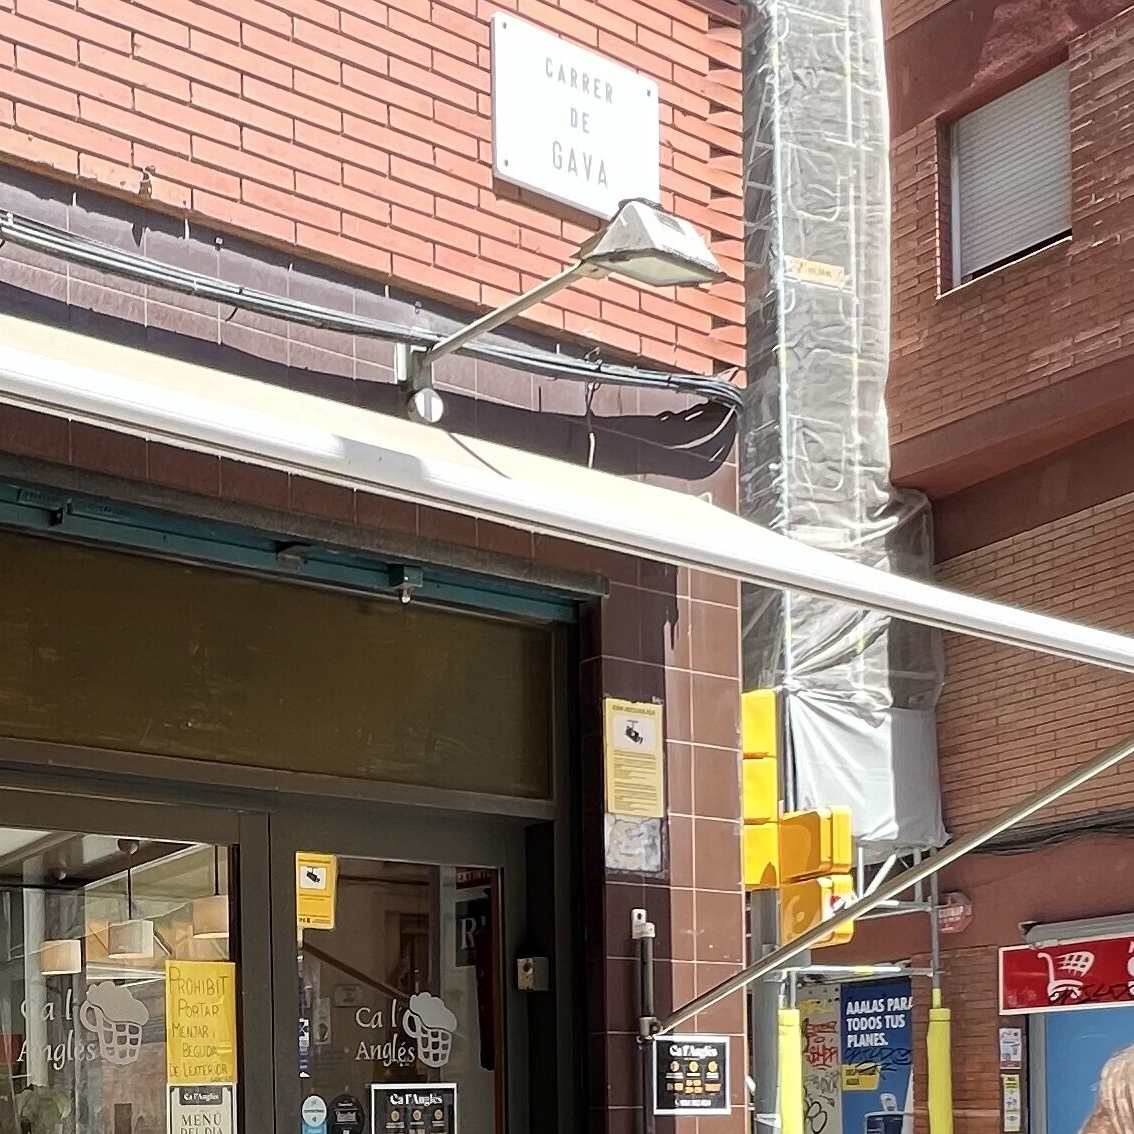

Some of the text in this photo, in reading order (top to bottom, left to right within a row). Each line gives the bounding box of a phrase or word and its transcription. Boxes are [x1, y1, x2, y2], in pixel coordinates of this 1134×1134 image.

[545, 56, 613, 104] CARRER
[570, 106, 590, 134] DE
[552, 140, 609, 189] GAVA
[168, 965, 229, 996] PROHIBIT
[177, 998, 220, 1018] PORTAR
[846, 998, 885, 1016] AAALAS
[355, 1006, 383, 1029] Ca
[846, 1013, 907, 1032] TODOS TUS
[171, 1022, 209, 1039] MENJAR
[847, 1032, 889, 1048] PLANES.
[355, 1033, 416, 1067] Anglés
[390, 1093, 404, 1105] Ca
[181, 1111, 222, 1127] MENÚ
